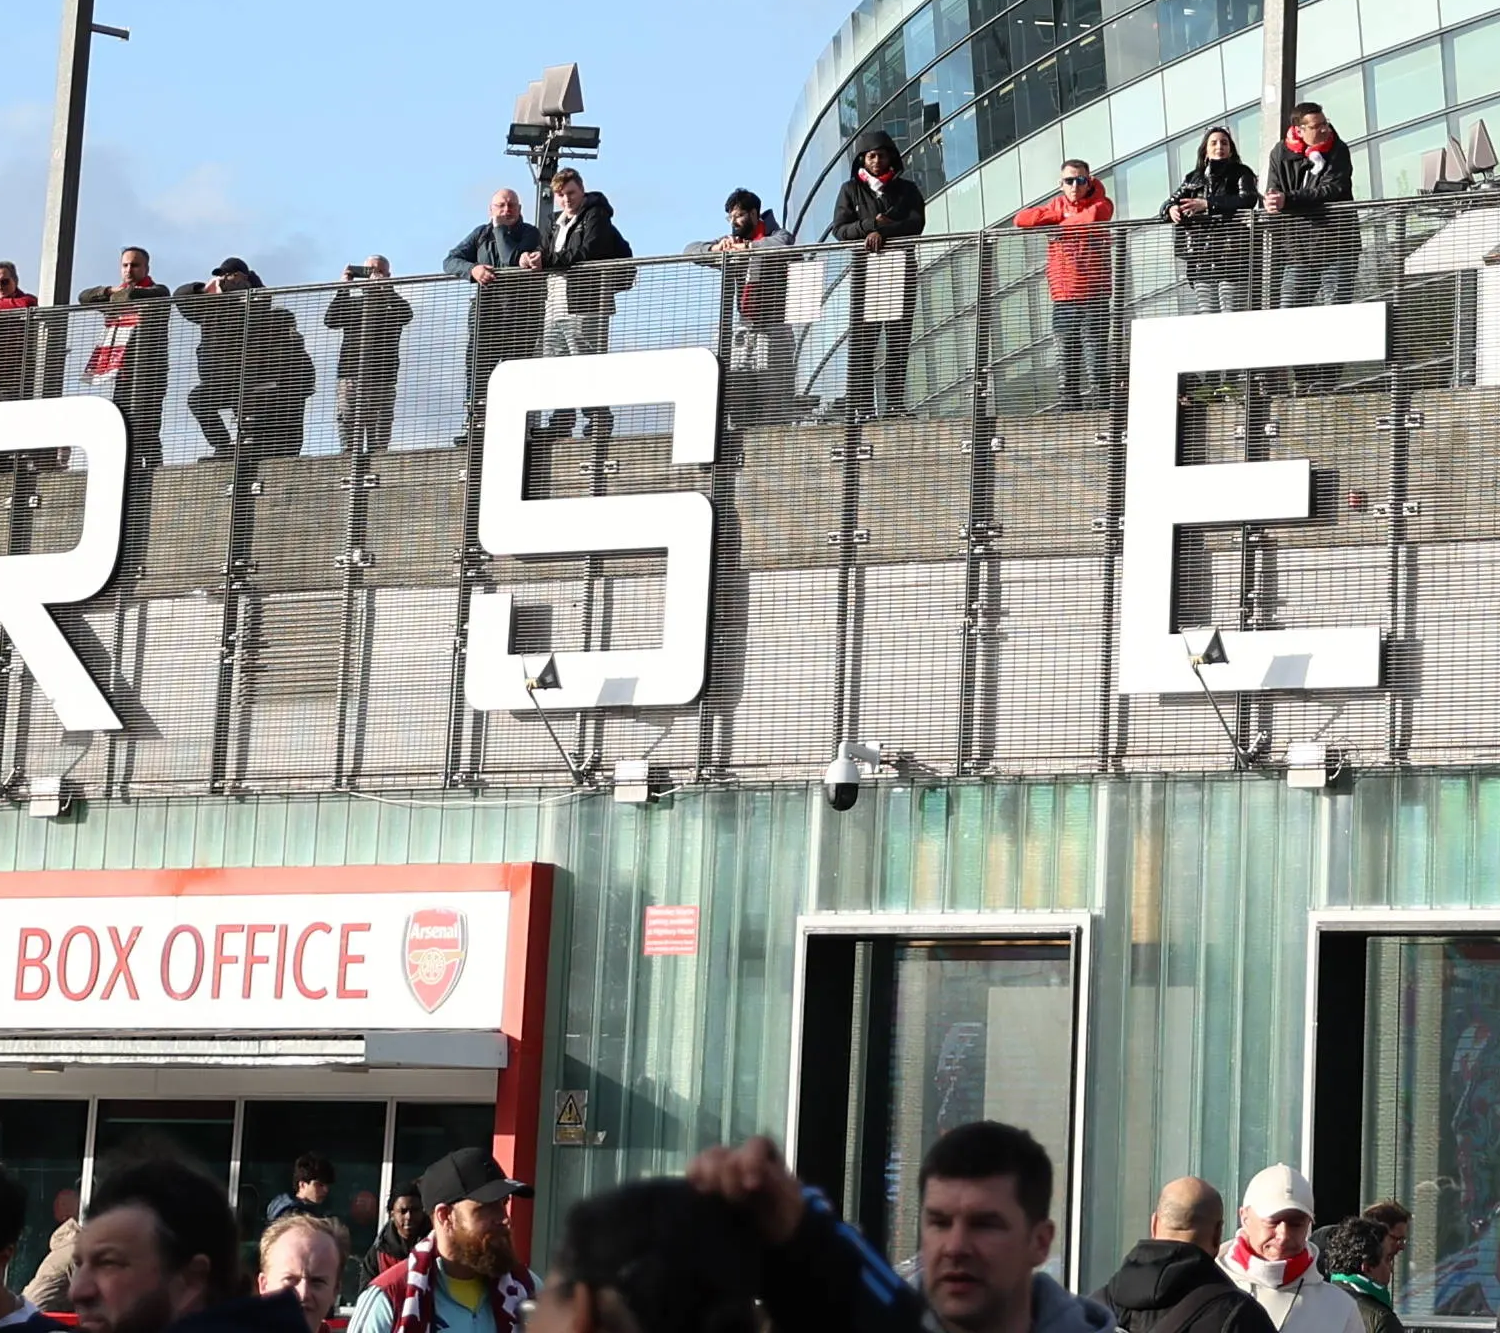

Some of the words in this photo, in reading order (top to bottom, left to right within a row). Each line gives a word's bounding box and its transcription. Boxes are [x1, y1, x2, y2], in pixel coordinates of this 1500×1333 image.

[410, 922, 460, 940] Arsenal
[14, 924, 141, 1002] BOX
[159, 920, 371, 1000] OFFICE
